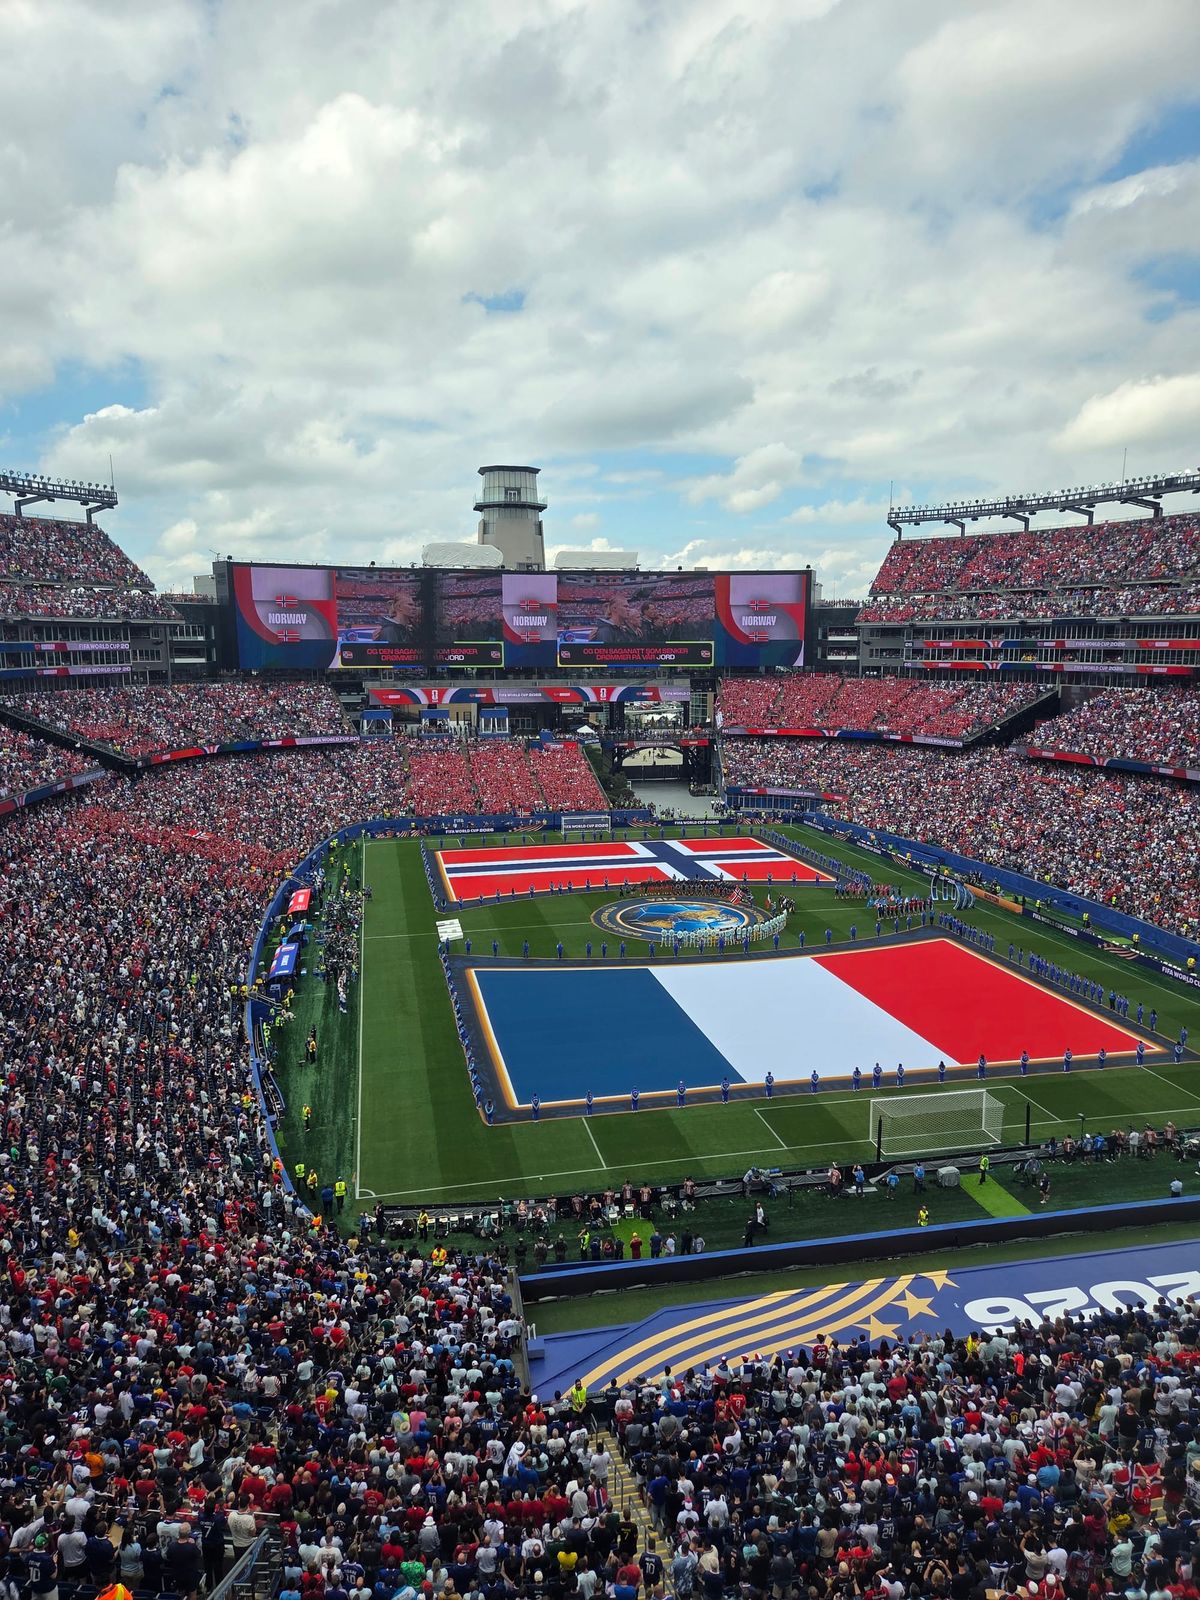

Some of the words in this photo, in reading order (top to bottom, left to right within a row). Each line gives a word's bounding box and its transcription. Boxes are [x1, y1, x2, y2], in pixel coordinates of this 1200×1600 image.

[268, 612, 307, 625] NORWAY
[512, 615, 548, 627] NORWAY
[741, 615, 777, 627] NORWAY
[1062, 925, 1078, 936] 2026
[1161, 966, 1174, 976] FIFA
[1173, 970, 1194, 984] WORLD
[816, 1350, 827, 1360] 22
[817, 1461, 824, 1472] 5
[833, 1490, 843, 1502] 10
[203, 1525, 212, 1539] 7
[882, 1525, 895, 1539] 24
[645, 1561, 655, 1575] 10
[29, 1566, 41, 1583] 10
